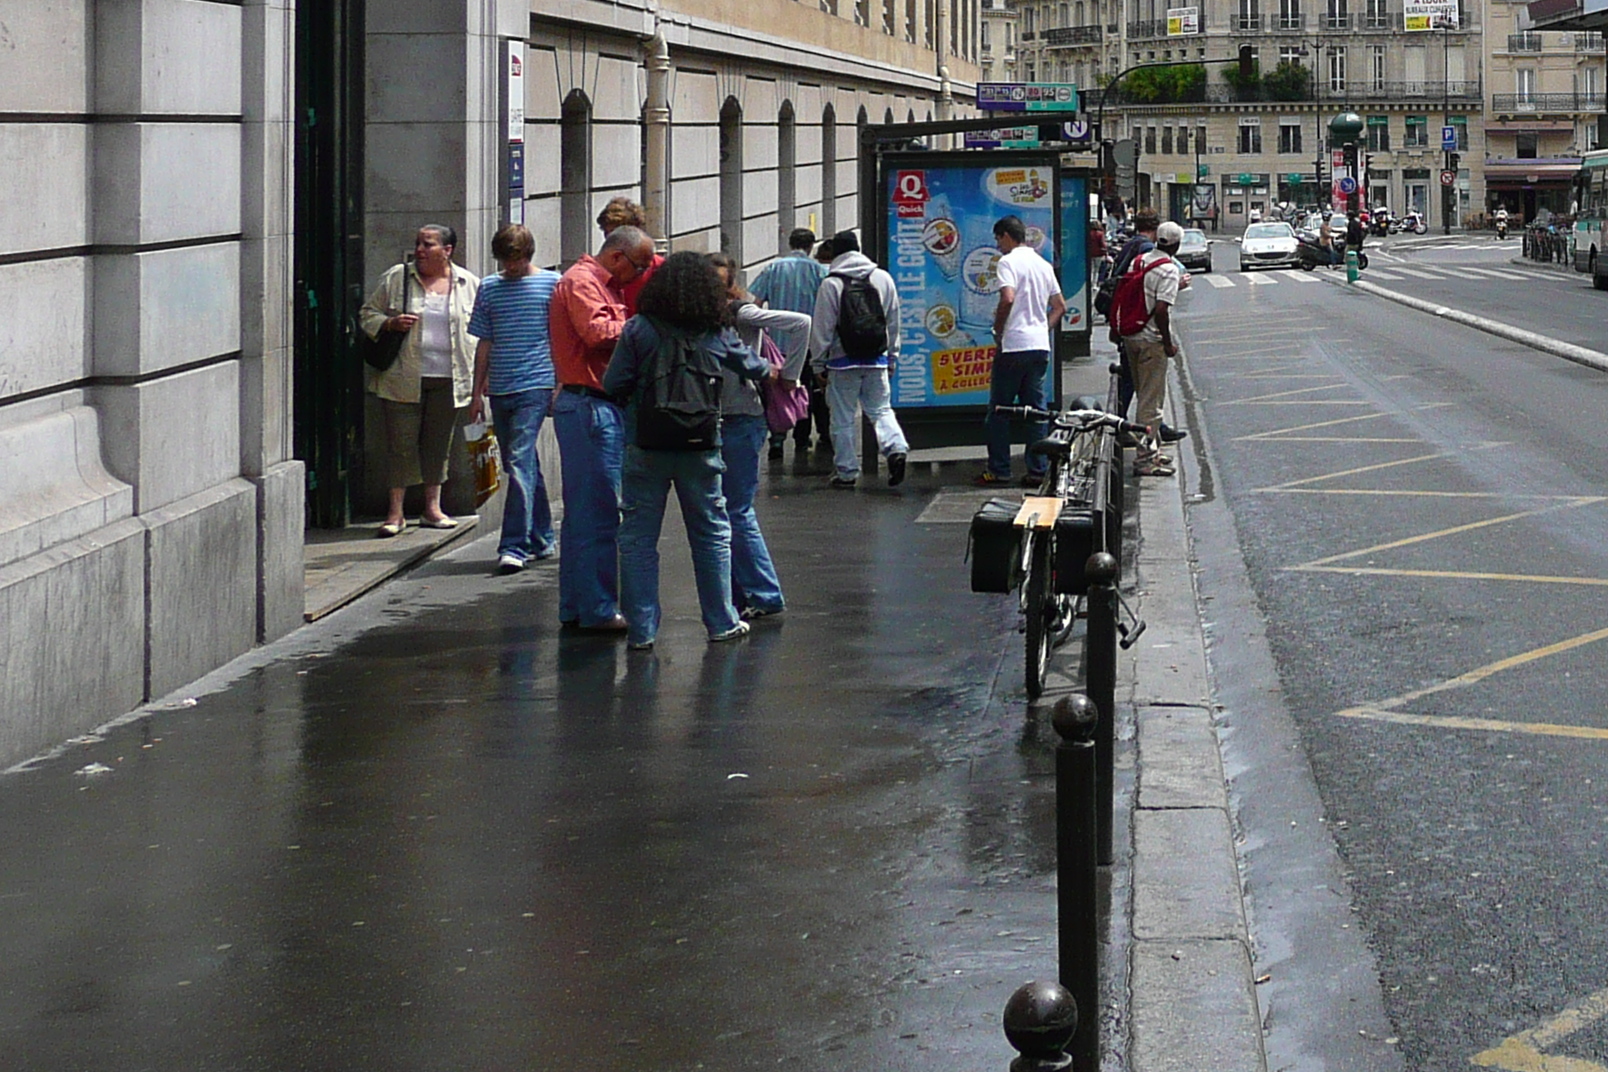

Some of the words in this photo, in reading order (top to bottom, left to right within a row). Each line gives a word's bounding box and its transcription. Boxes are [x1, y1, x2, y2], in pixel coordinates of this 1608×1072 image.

[1445, 129, 1452, 140] P
[901, 175, 923, 199] Q
[898, 205, 923, 214] Quick
[898, 271, 926, 291] LE
[939, 353, 949, 366] 5
[898, 347, 930, 403] NOUS,
